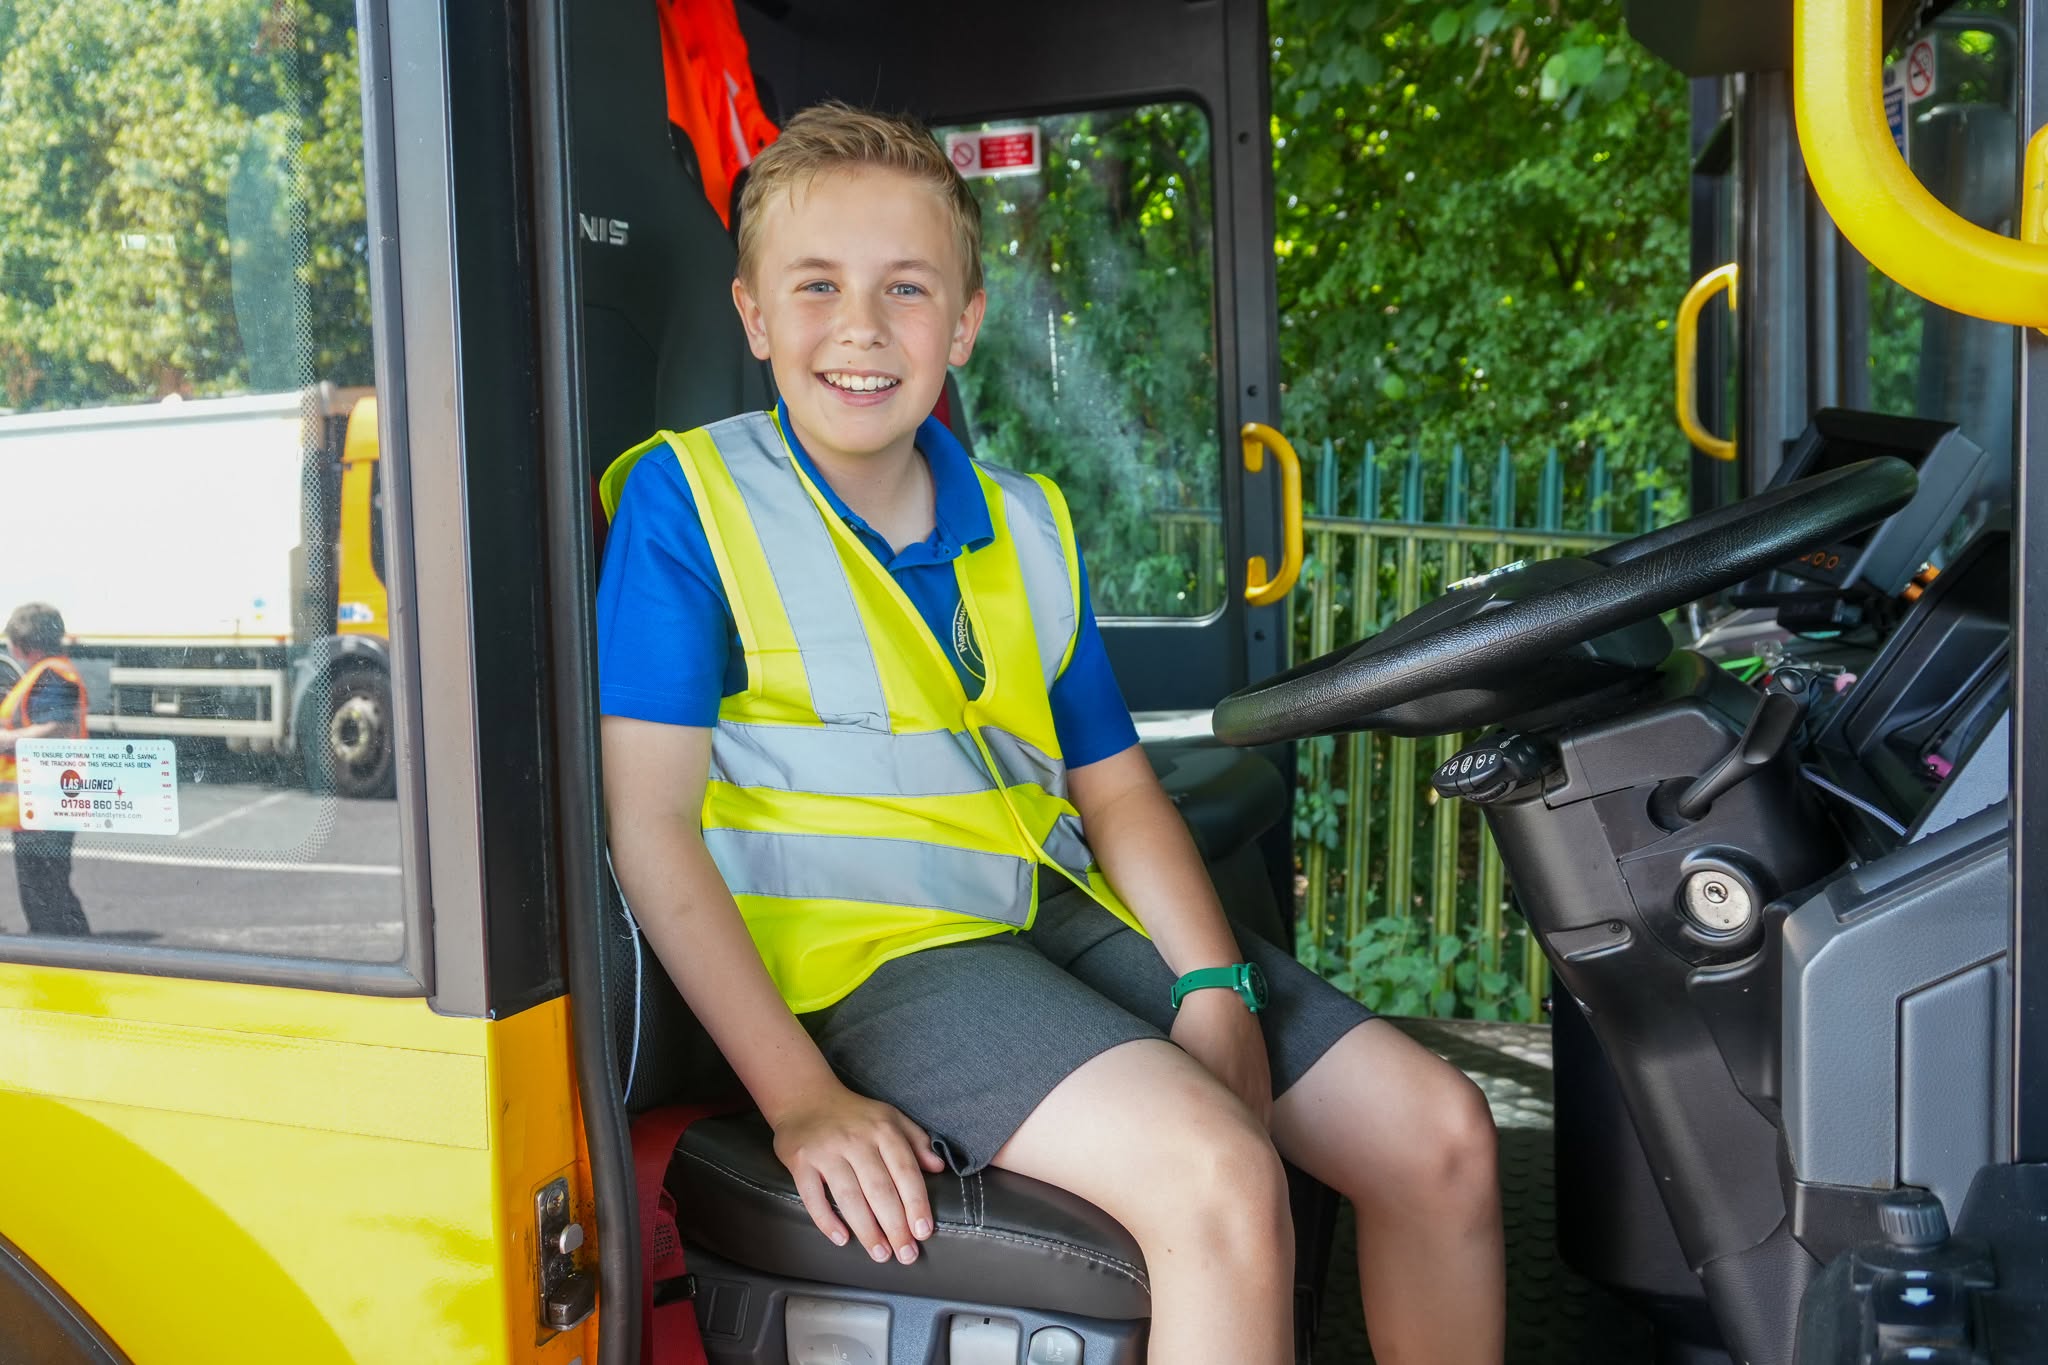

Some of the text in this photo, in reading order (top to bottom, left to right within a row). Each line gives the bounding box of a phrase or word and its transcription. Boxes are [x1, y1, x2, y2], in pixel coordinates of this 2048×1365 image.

[579, 212, 629, 245] NIS
[956, 605, 968, 653] Mapplew
[54, 810, 142, 820] www.savefuelandtyres.com
[61, 799, 133, 811] 01788 860 594
